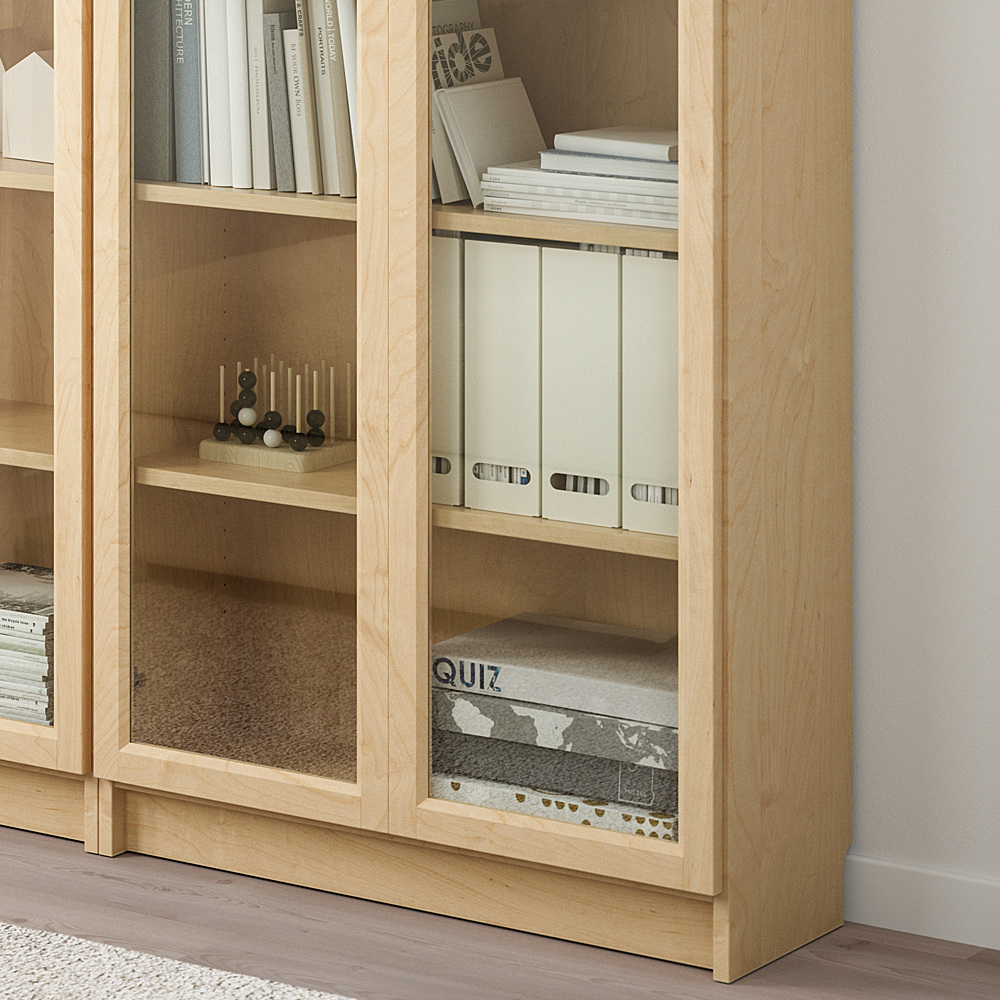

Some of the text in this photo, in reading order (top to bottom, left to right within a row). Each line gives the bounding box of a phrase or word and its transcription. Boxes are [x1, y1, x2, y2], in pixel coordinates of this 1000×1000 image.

[318, 27, 326, 76] PORTRAITS
[327, 33, 336, 62] TODAY
[432, 657, 501, 692] QUIZ
